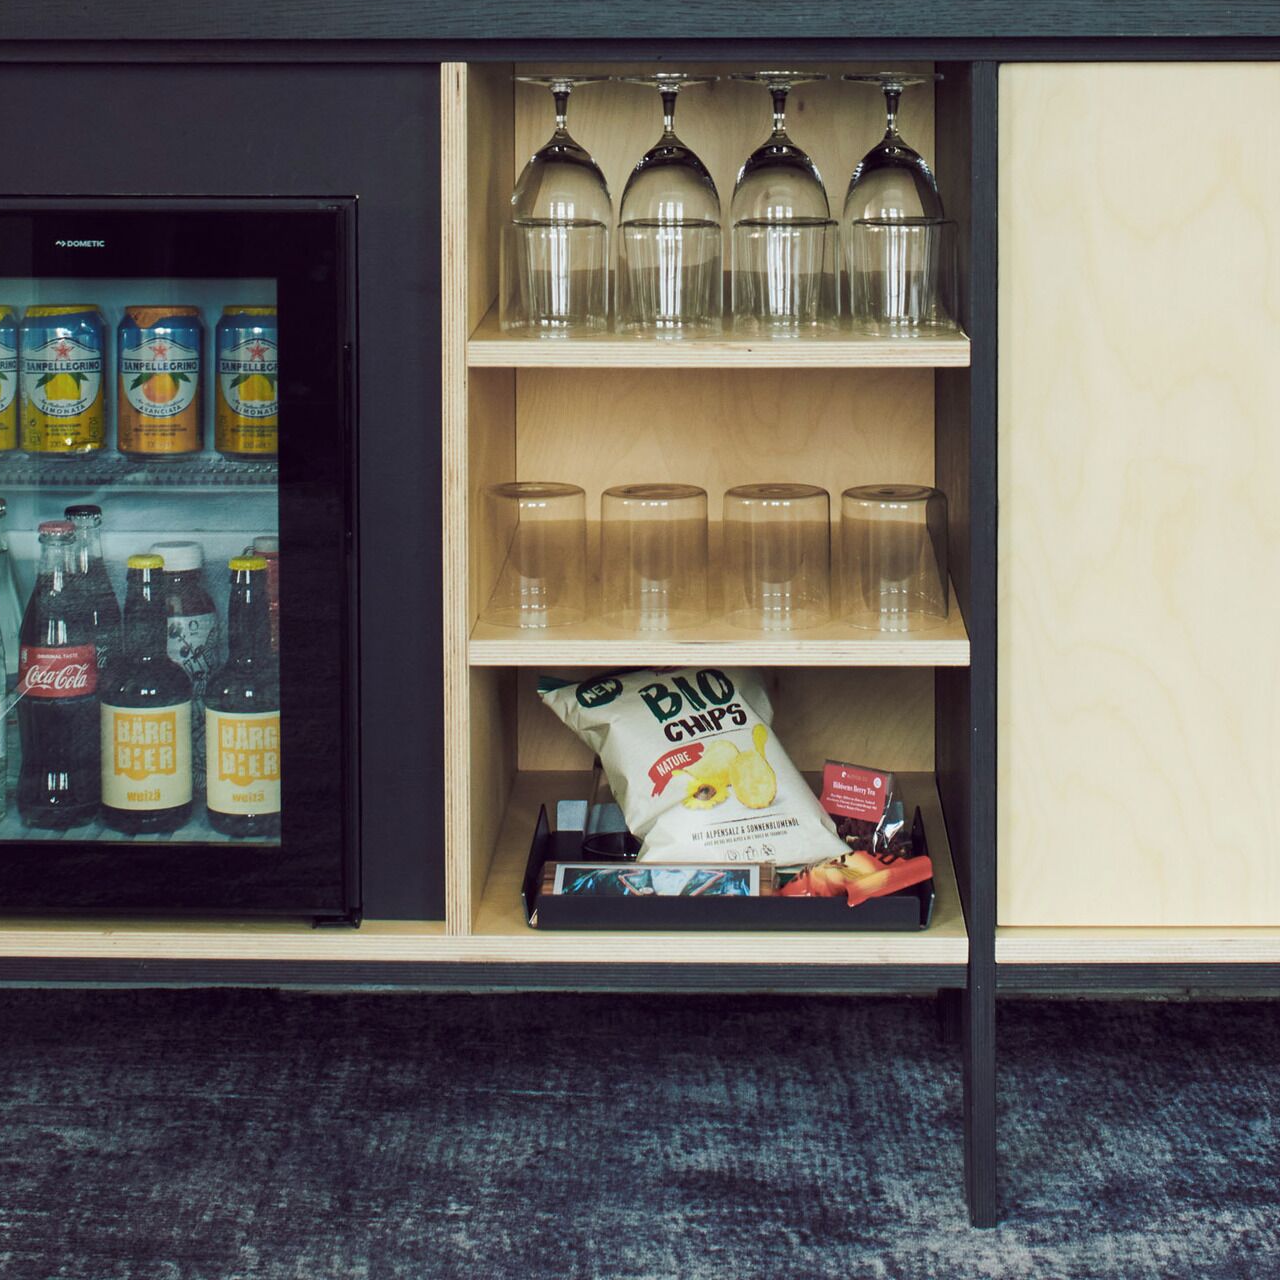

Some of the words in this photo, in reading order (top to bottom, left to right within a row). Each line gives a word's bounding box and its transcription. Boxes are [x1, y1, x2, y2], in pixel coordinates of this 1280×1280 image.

[26, 360, 100, 371] SANPELLEGRINO
[124, 361, 197, 371] SANPELLEGRINO
[41, 404, 86, 414] LIMONATA
[25, 664, 89, 689] Coca-Cola
[581, 680, 617, 704] NEW
[638, 669, 735, 724] BIO
[117, 717, 173, 745] BÄRG
[664, 703, 747, 742] CHIPS
[221, 723, 278, 750] BÄRG
[656, 751, 692, 777] NATURE
[127, 789, 161, 802] weizä
[232, 791, 265, 803] weizä
[867, 788, 876, 796] Tea
[692, 831, 704, 841] MIT
[706, 826, 739, 839] ALPENSALZ
